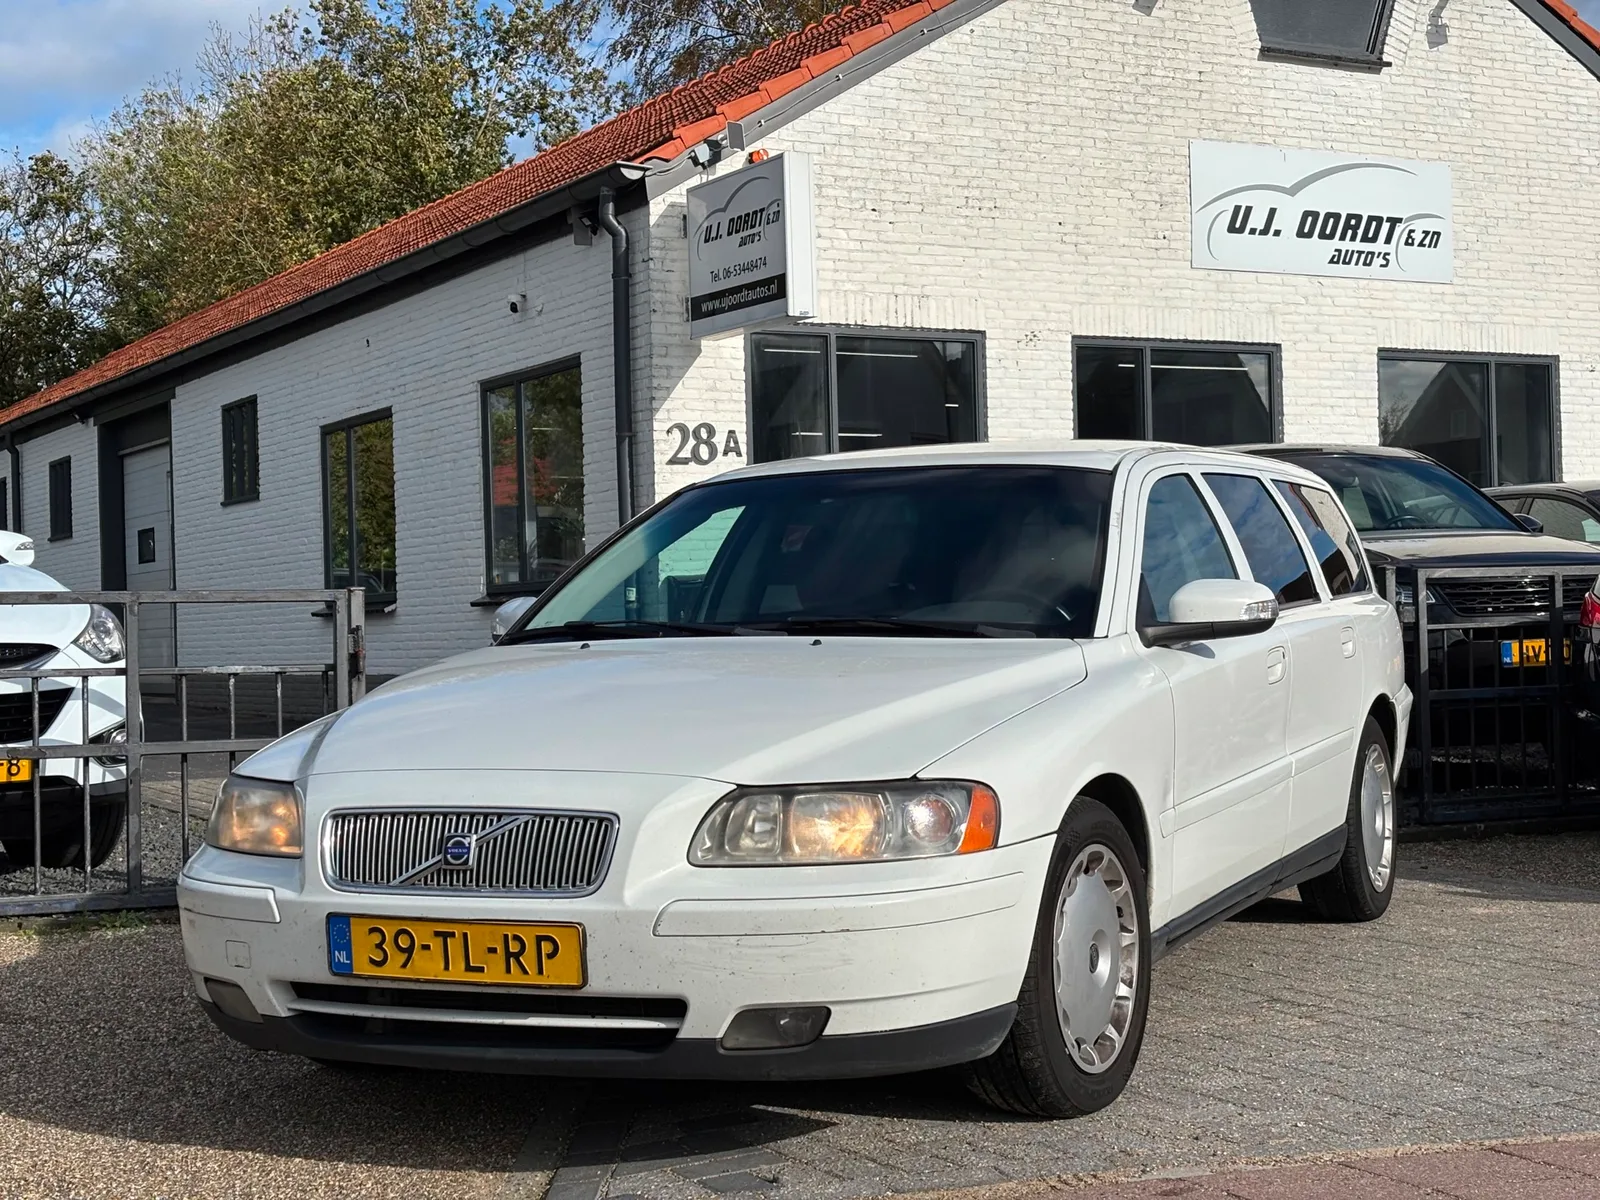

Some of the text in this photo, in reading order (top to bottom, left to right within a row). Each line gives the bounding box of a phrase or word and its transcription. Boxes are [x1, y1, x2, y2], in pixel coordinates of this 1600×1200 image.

[703, 221, 723, 244] U.J.
[726, 207, 765, 237] OORDT
[1226, 204, 1282, 237] U.J.
[1295, 209, 1403, 245] OORDT
[710, 256, 767, 283] Tel. 06-53448474
[701, 279, 778, 312] www.ujoordtautos.nl
[665, 422, 743, 466] 28 A
[335, 950, 350, 964] NL
[367, 926, 560, 976] 39-TL-RP
